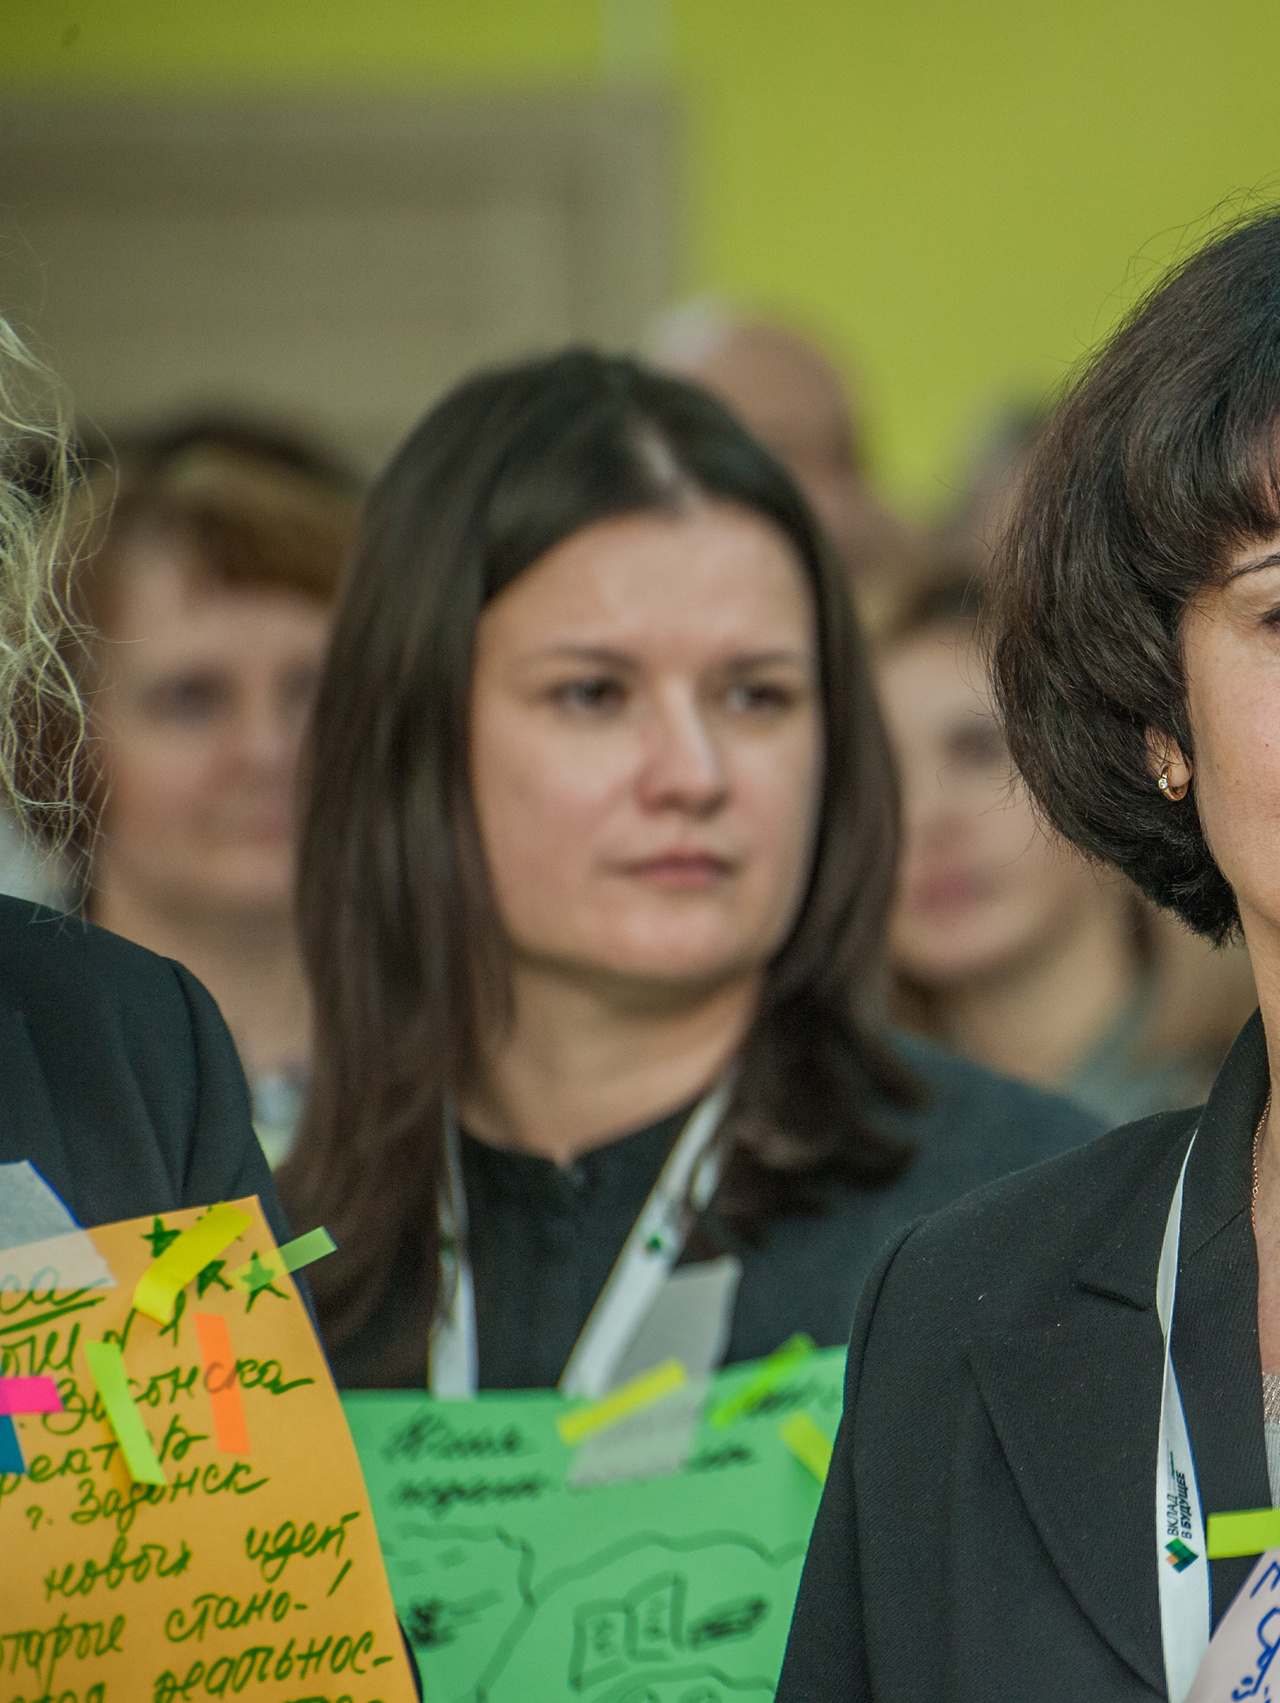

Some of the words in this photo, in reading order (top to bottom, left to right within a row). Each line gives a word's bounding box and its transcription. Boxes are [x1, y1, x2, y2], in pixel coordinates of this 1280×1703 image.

[1166, 1493, 1179, 1537] ВКЛАД
[1175, 1469, 1193, 1530] БУДУЩЕЕ
[1181, 1530, 1193, 1540] В
